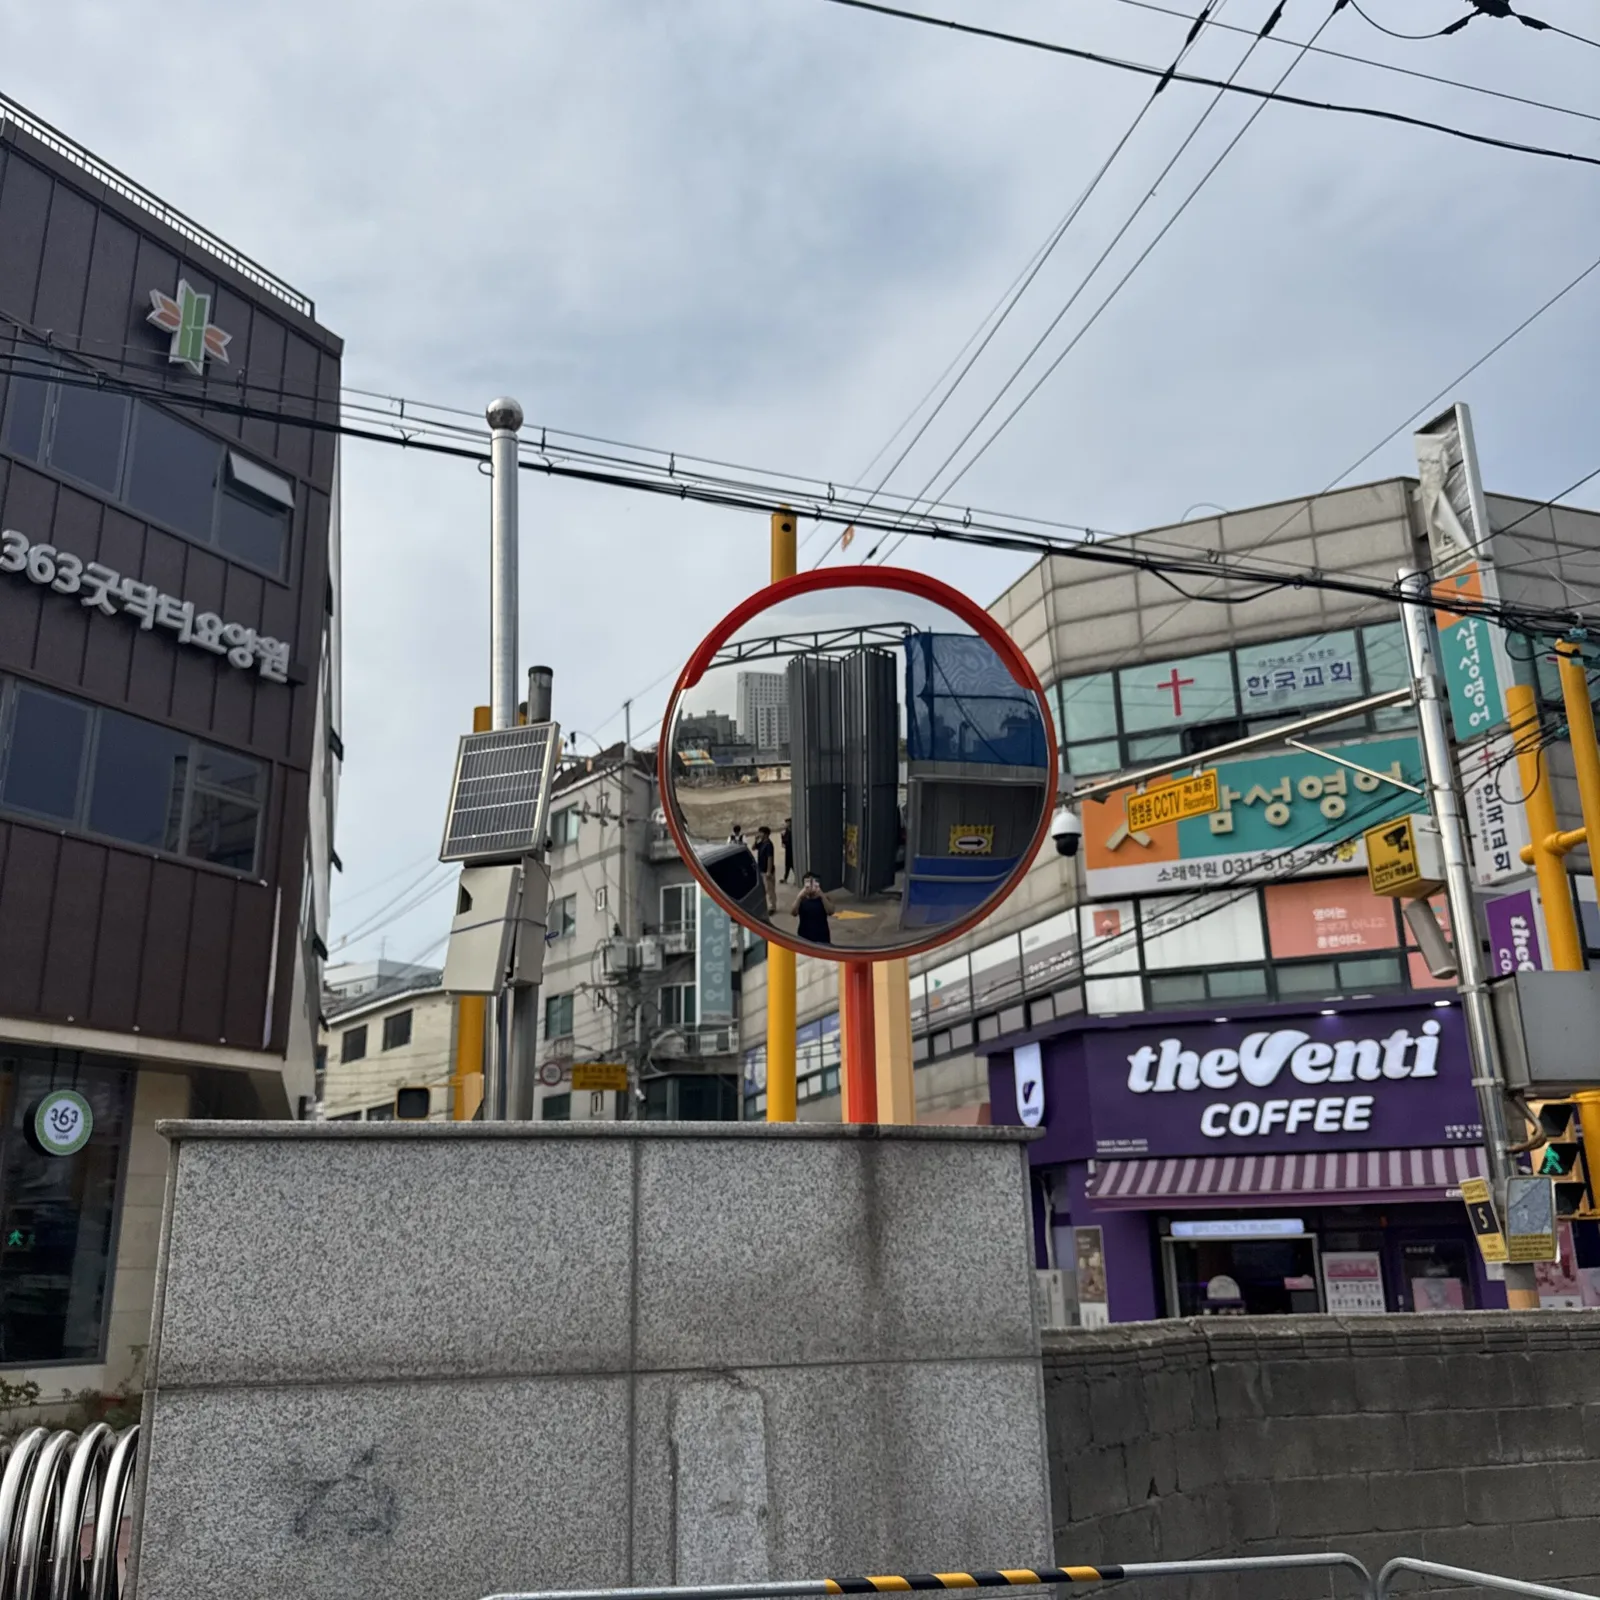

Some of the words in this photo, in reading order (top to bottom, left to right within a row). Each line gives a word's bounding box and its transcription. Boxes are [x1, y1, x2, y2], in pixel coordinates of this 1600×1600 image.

[0, 529, 291, 684] 363굿닥터요양원
[1246, 661, 1353, 697] 한국교회
[1456, 619, 1490, 727] 삼성영어
[1153, 788, 1181, 820] CCTV
[1156, 861, 1219, 883] 소래학원
[50, 1106, 79, 1126] 363
[1200, 1096, 1374, 1137] COFFEE
